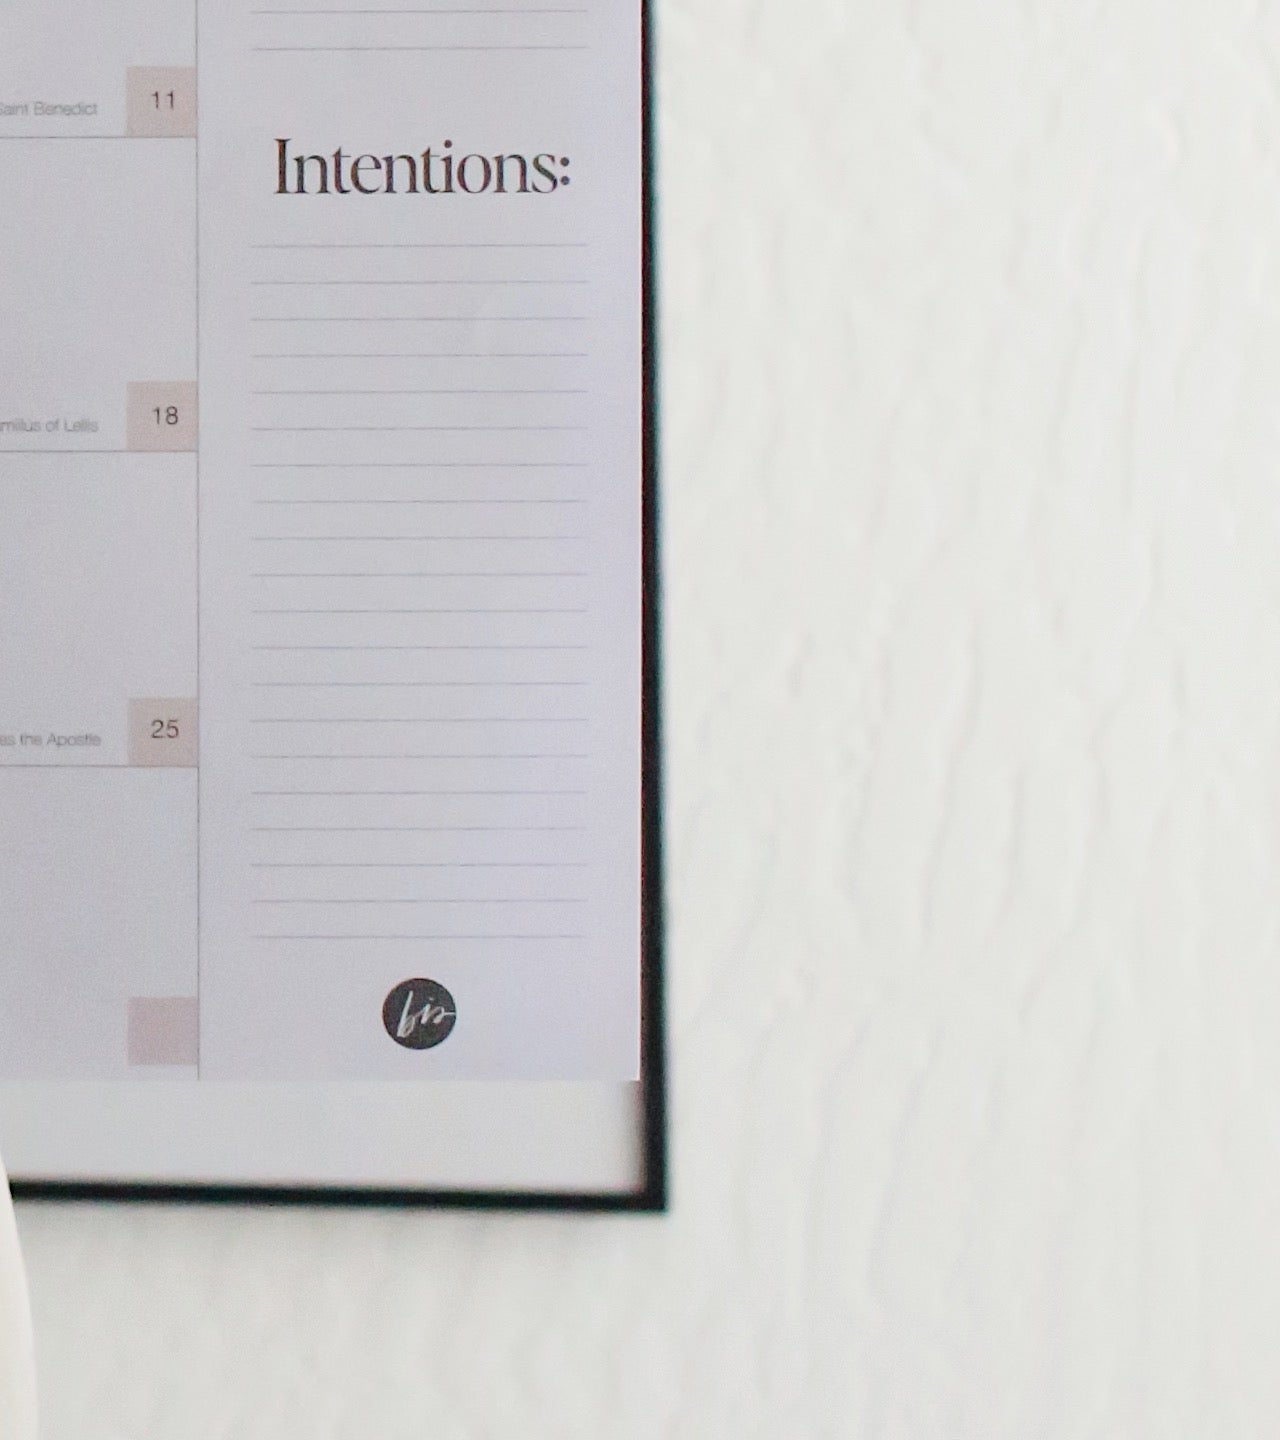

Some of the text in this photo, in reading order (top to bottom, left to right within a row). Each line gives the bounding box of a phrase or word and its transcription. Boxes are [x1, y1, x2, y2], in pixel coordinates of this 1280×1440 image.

[33, 100, 98, 117] Benedict
[152, 90, 175, 109] 11
[275, 138, 570, 195] Intentions:
[153, 405, 179, 426] 18
[45, 418, 60, 433] of
[150, 718, 180, 739] 25
[19, 733, 43, 746] the
[46, 732, 102, 749] Apostle
